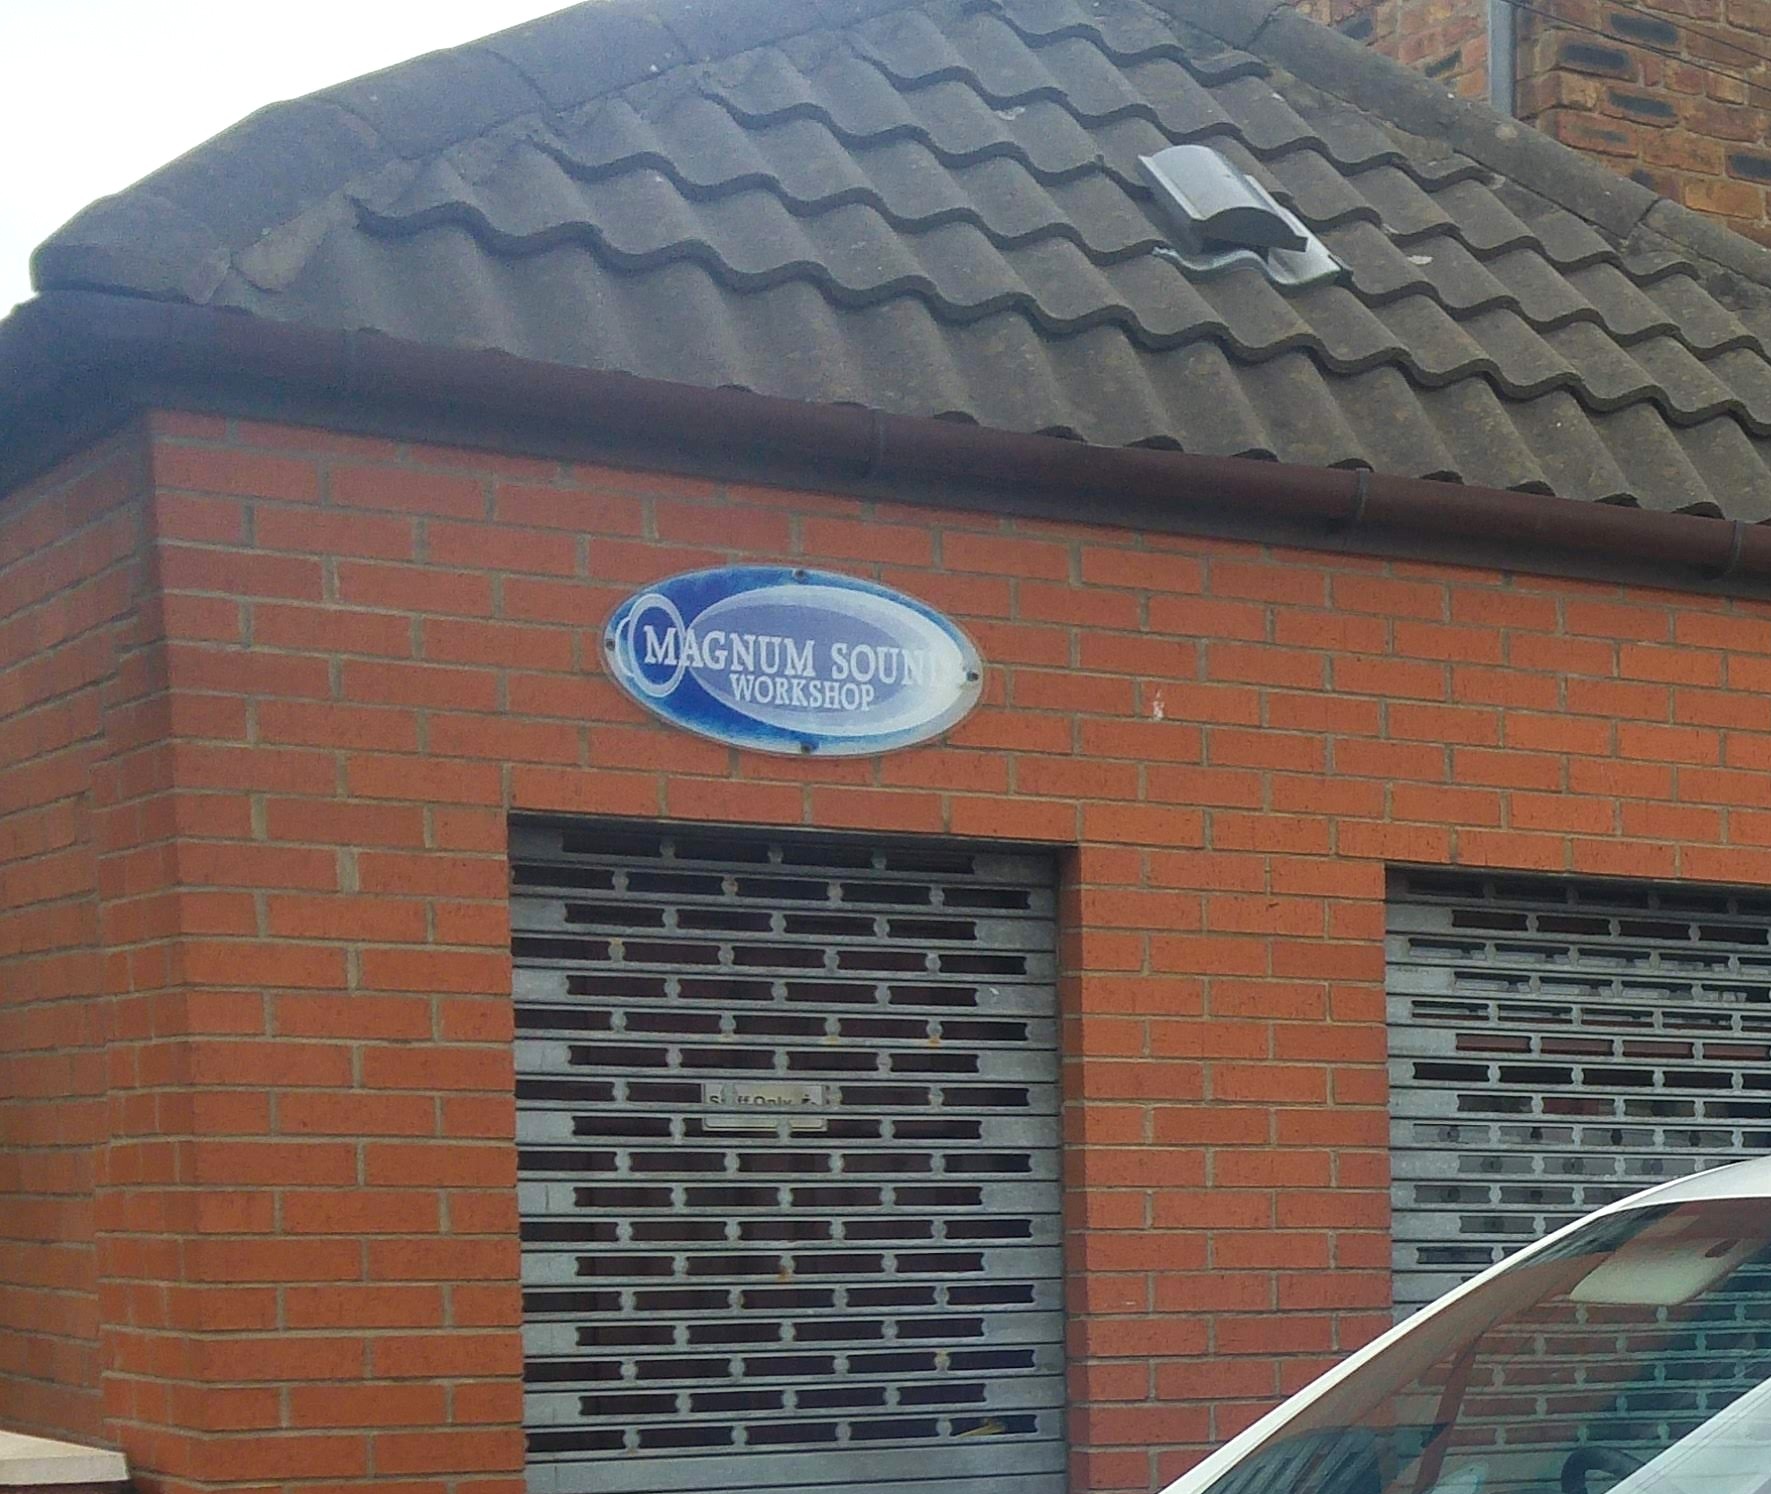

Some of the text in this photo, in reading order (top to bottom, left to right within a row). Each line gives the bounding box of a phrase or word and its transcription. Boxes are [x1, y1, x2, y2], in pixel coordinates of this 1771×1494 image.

[643, 624, 947, 690] MAGNUM SOUN
[730, 673, 874, 711] WORKSHOP
